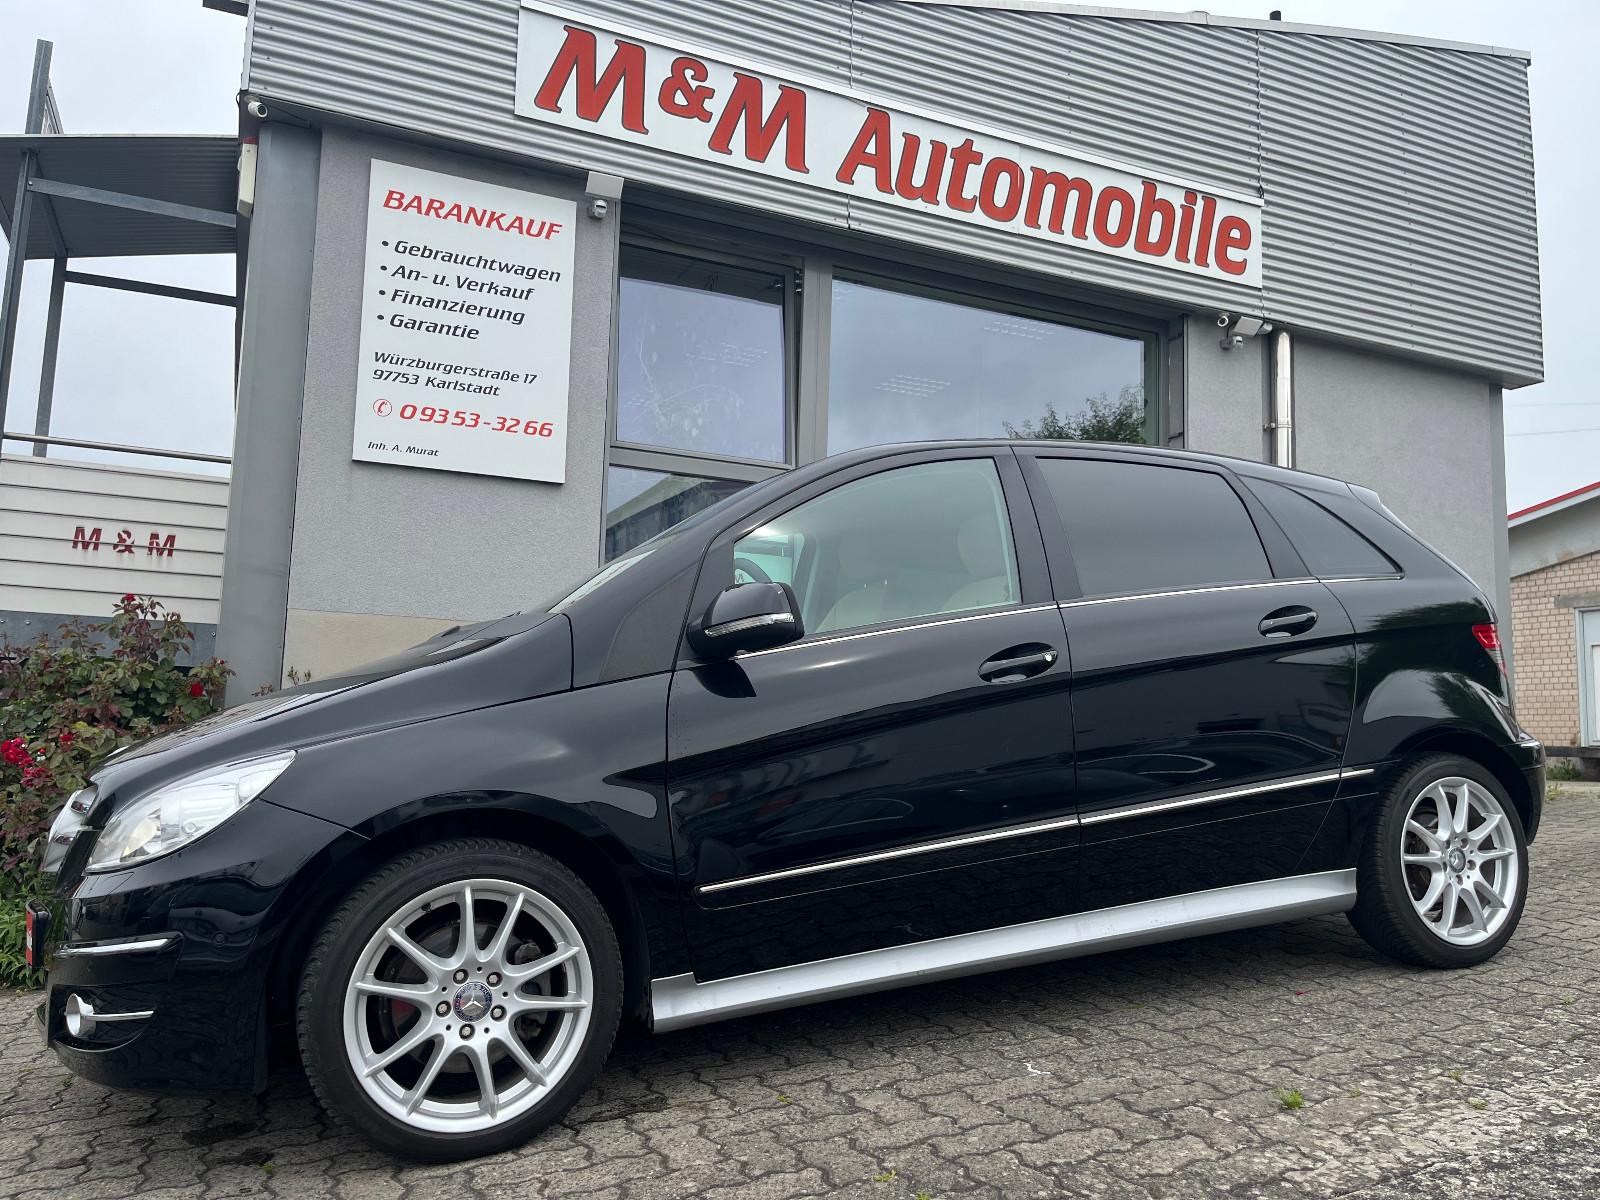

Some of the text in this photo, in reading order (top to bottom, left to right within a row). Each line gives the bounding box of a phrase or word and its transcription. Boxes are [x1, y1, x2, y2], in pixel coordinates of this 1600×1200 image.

[533, 25, 1252, 276] M&M Automobile
[383, 190, 562, 240] BARANKAUF
[394, 240, 561, 282] Gebrauchtwagen
[391, 265, 535, 301] An- u. Verkauf
[390, 289, 526, 325] Finanzierung
[389, 313, 480, 340] Garantie
[372, 369, 501, 396] 97753 Karlstadt
[374, 351, 538, 385] Würzburgerstraße 17
[367, 441, 440, 457] Inh. A. Murat
